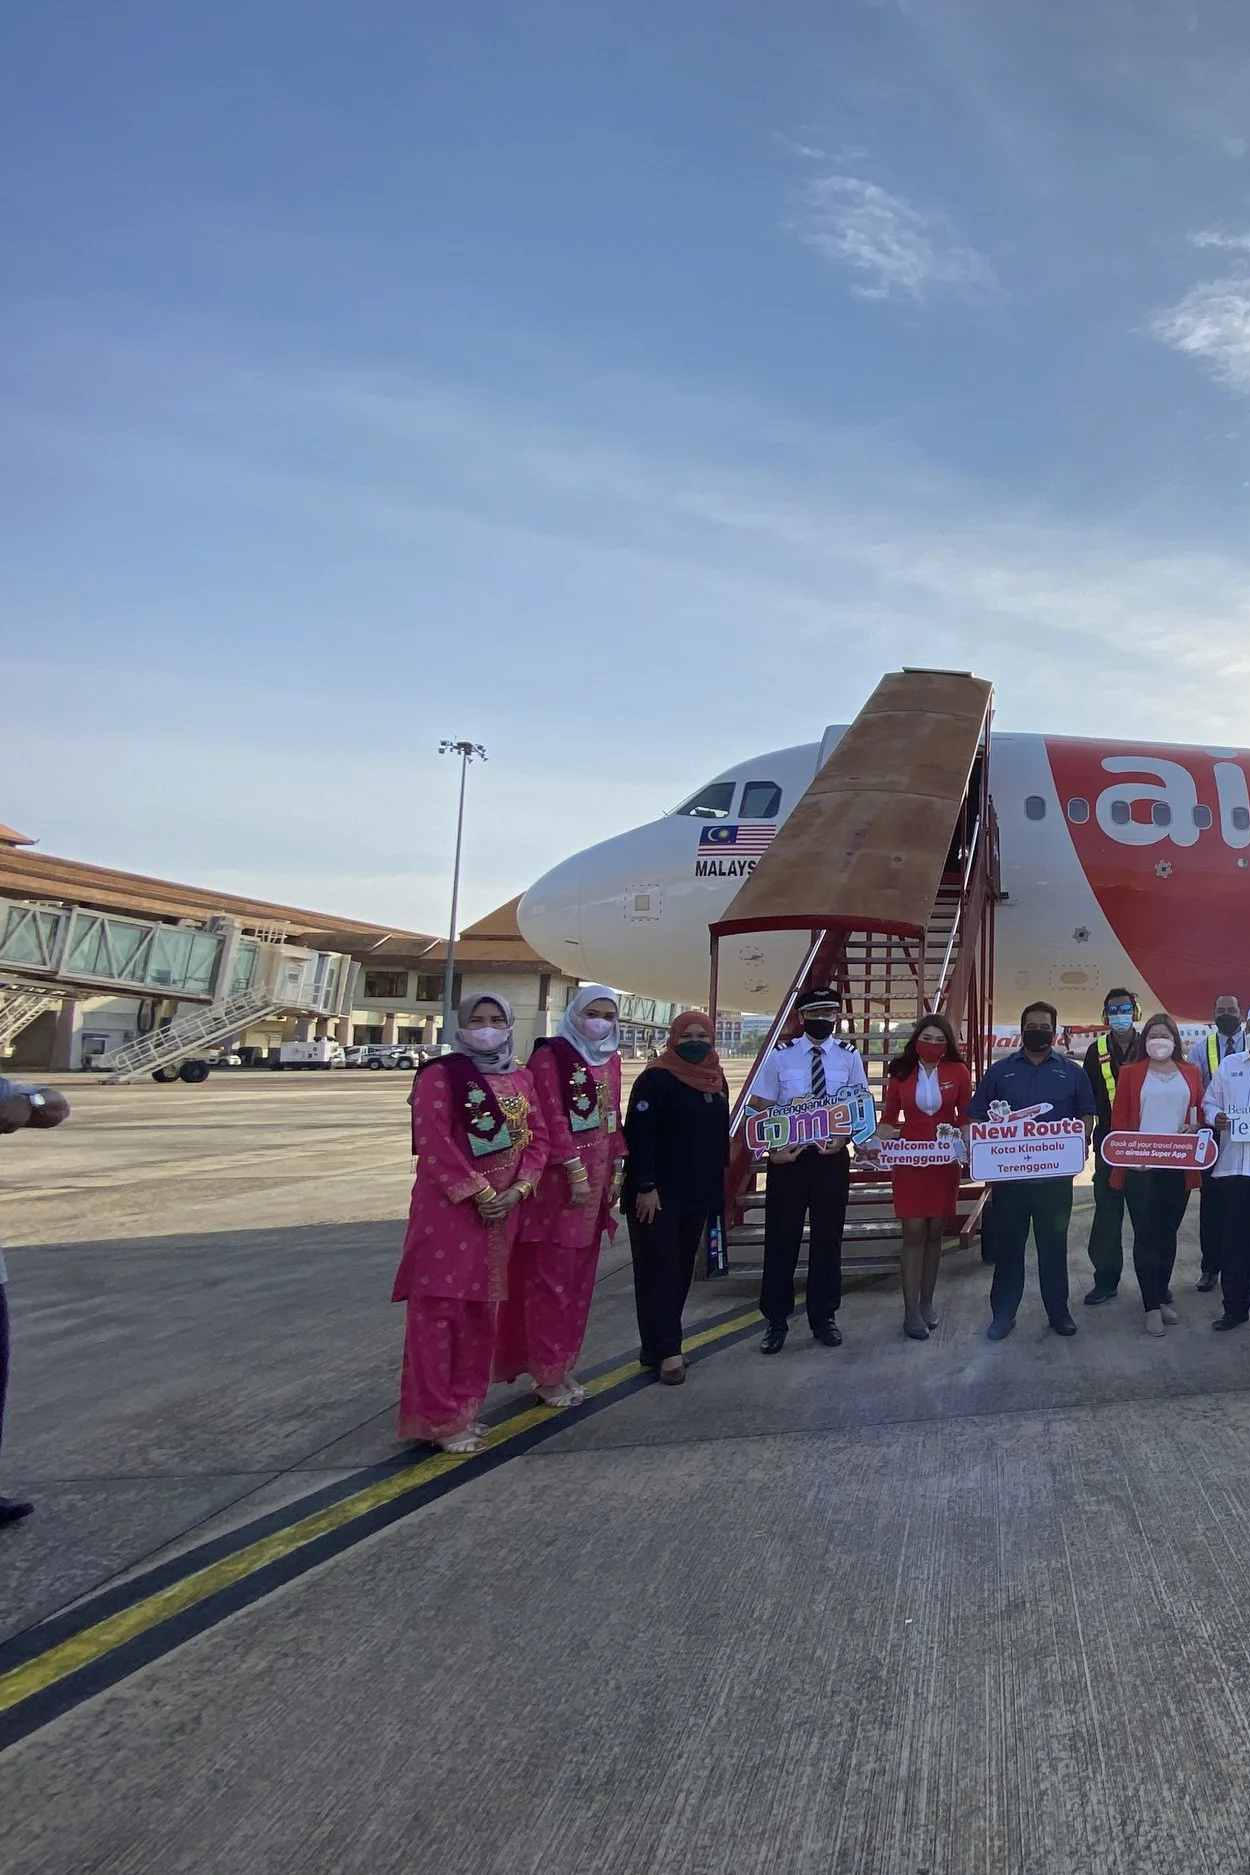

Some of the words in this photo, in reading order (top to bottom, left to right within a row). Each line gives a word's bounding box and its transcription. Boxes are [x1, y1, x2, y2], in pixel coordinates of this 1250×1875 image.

[695, 860, 757, 877] MALAYS
[972, 1124, 1018, 1140] New
[1023, 1120, 1083, 1137] Route
[881, 1141, 935, 1151] Welcome
[938, 1141, 950, 1150] to
[991, 1145, 1016, 1155] Kota
[1018, 1142, 1065, 1153] Kinabalu
[1153, 1141, 1172, 1149] travel
[1173, 1142, 1193, 1150] needs
[880, 1154, 951, 1165] Terengganu
[1150, 1150, 1171, 1159] Super
[1171, 1151, 1187, 1159] App
[997, 1163, 1060, 1174] Terengganu
